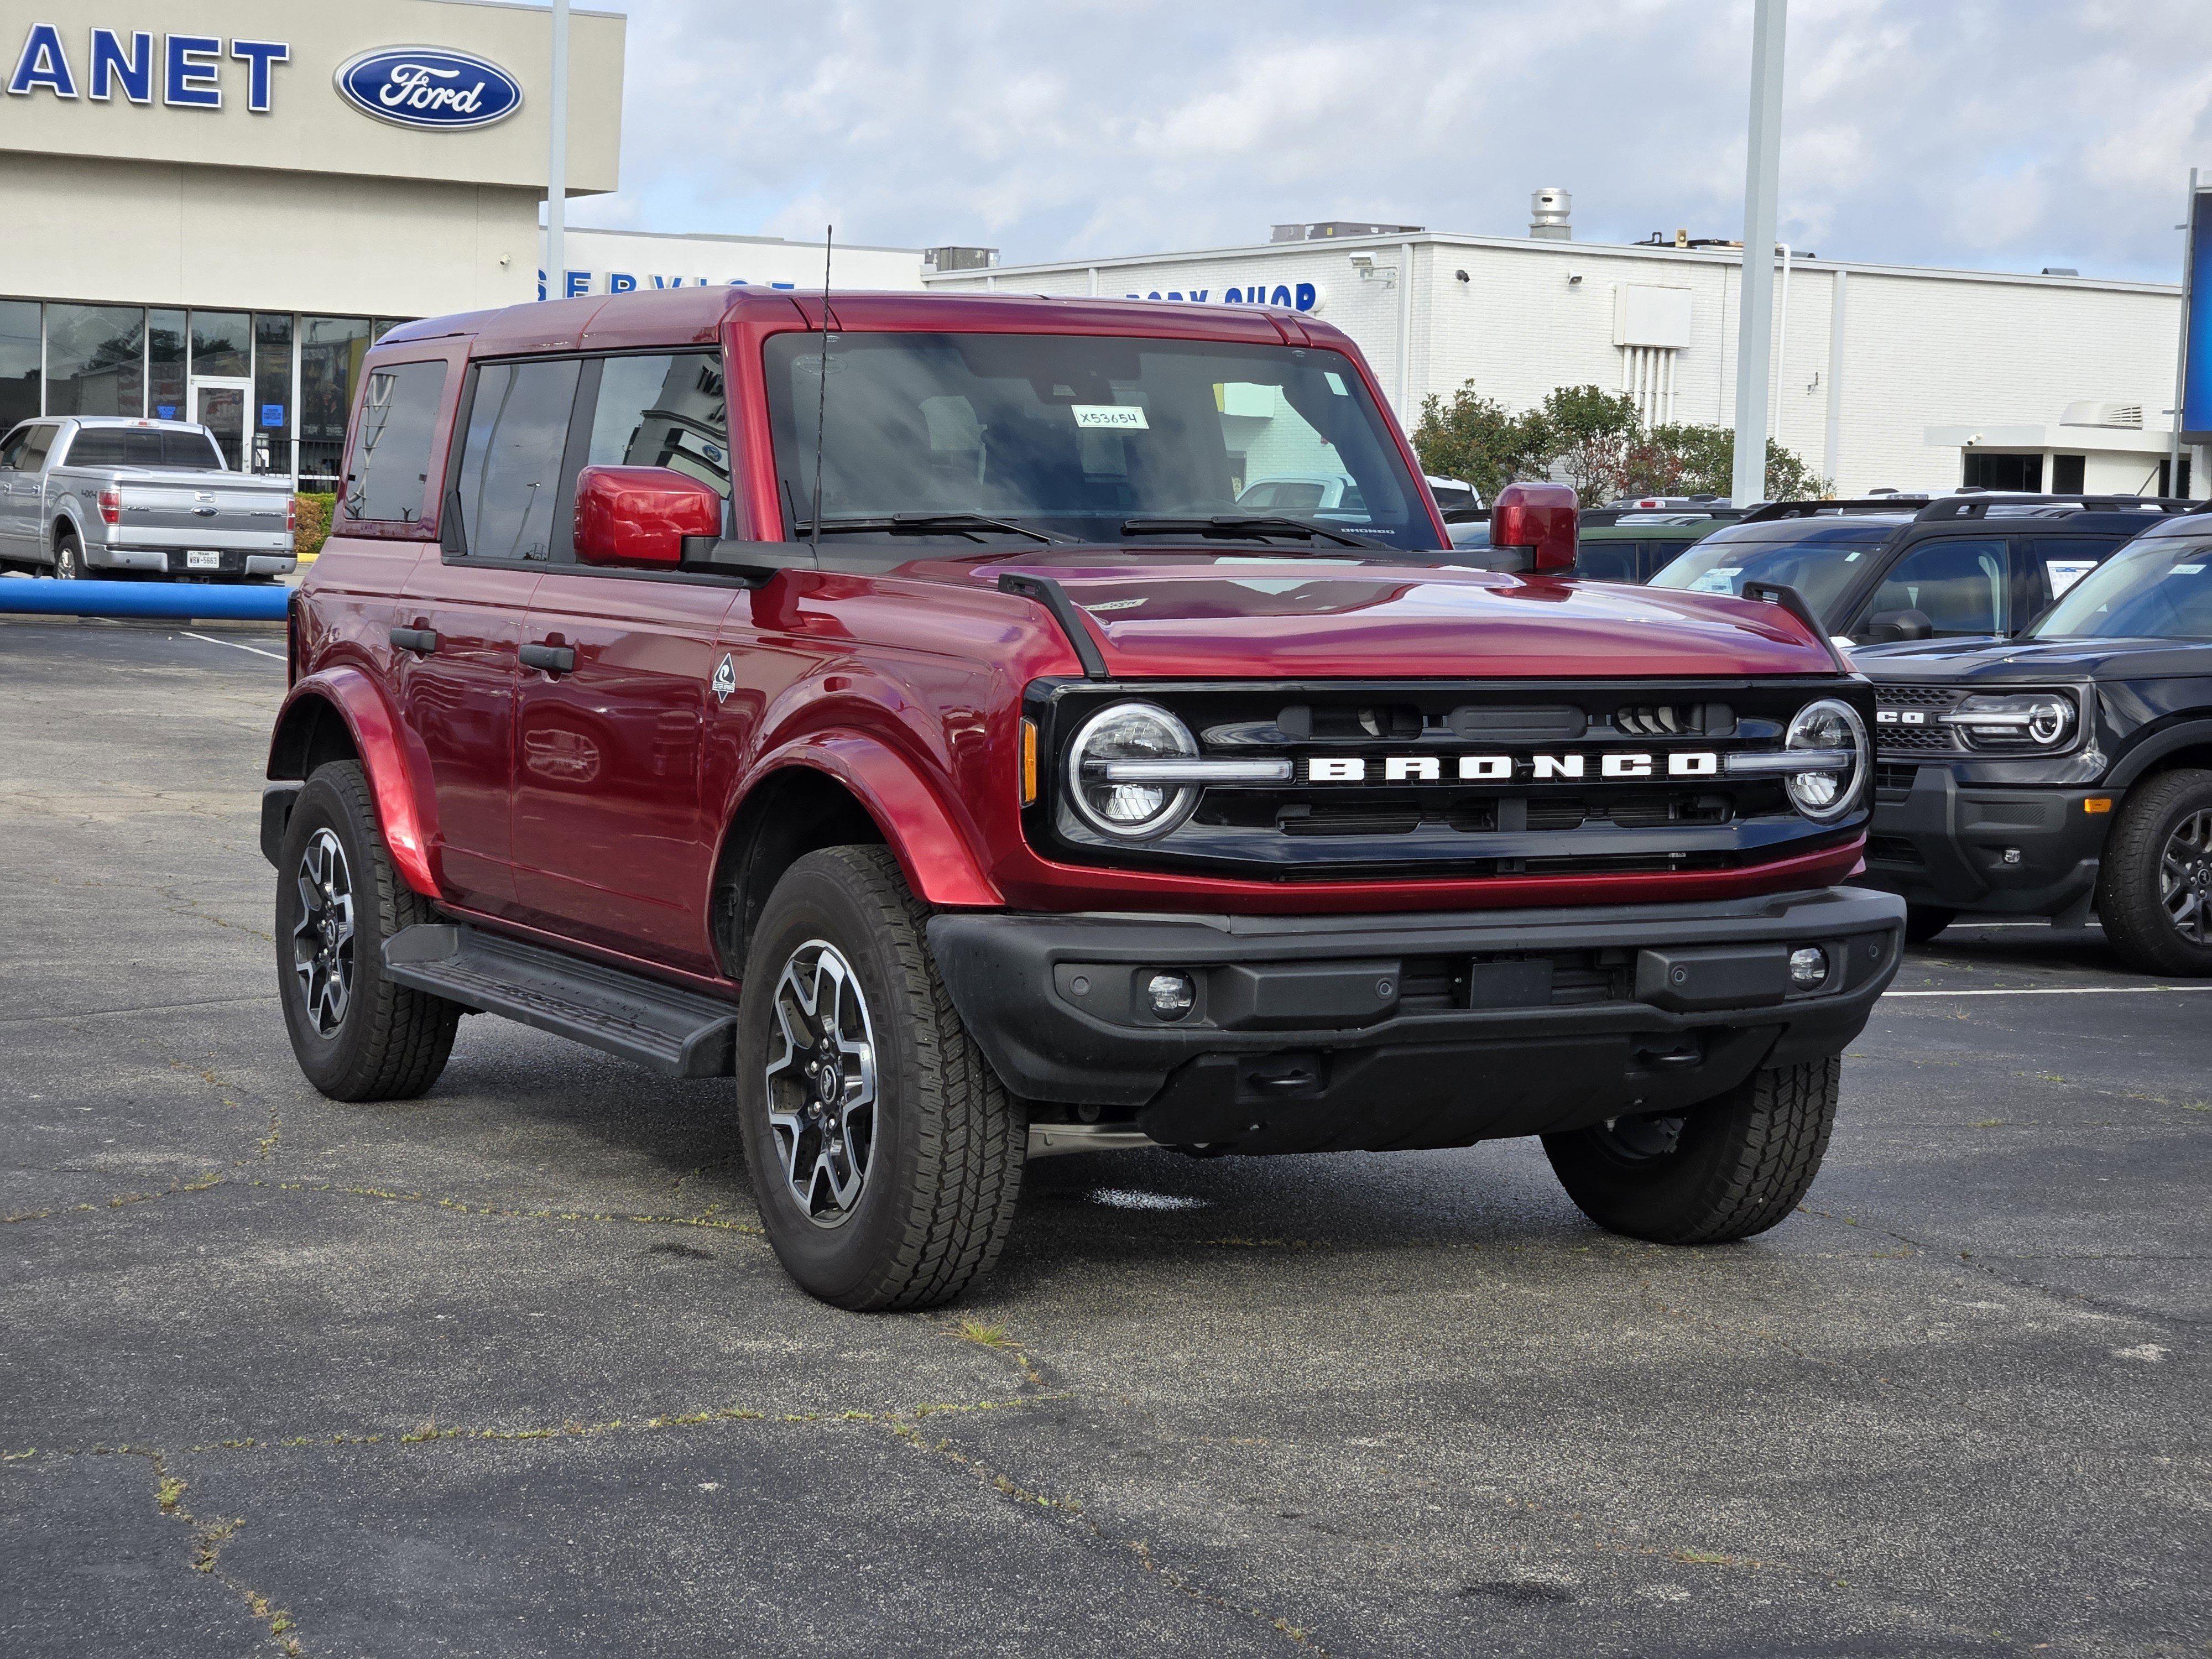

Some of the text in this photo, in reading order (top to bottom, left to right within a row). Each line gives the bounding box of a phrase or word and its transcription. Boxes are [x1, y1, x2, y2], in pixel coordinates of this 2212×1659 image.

[0, 22, 290, 111] ANET
[379, 64, 486, 113] Ford
[1080, 414, 1138, 424] X53654
[1308, 753, 1717, 781] BRONCO
